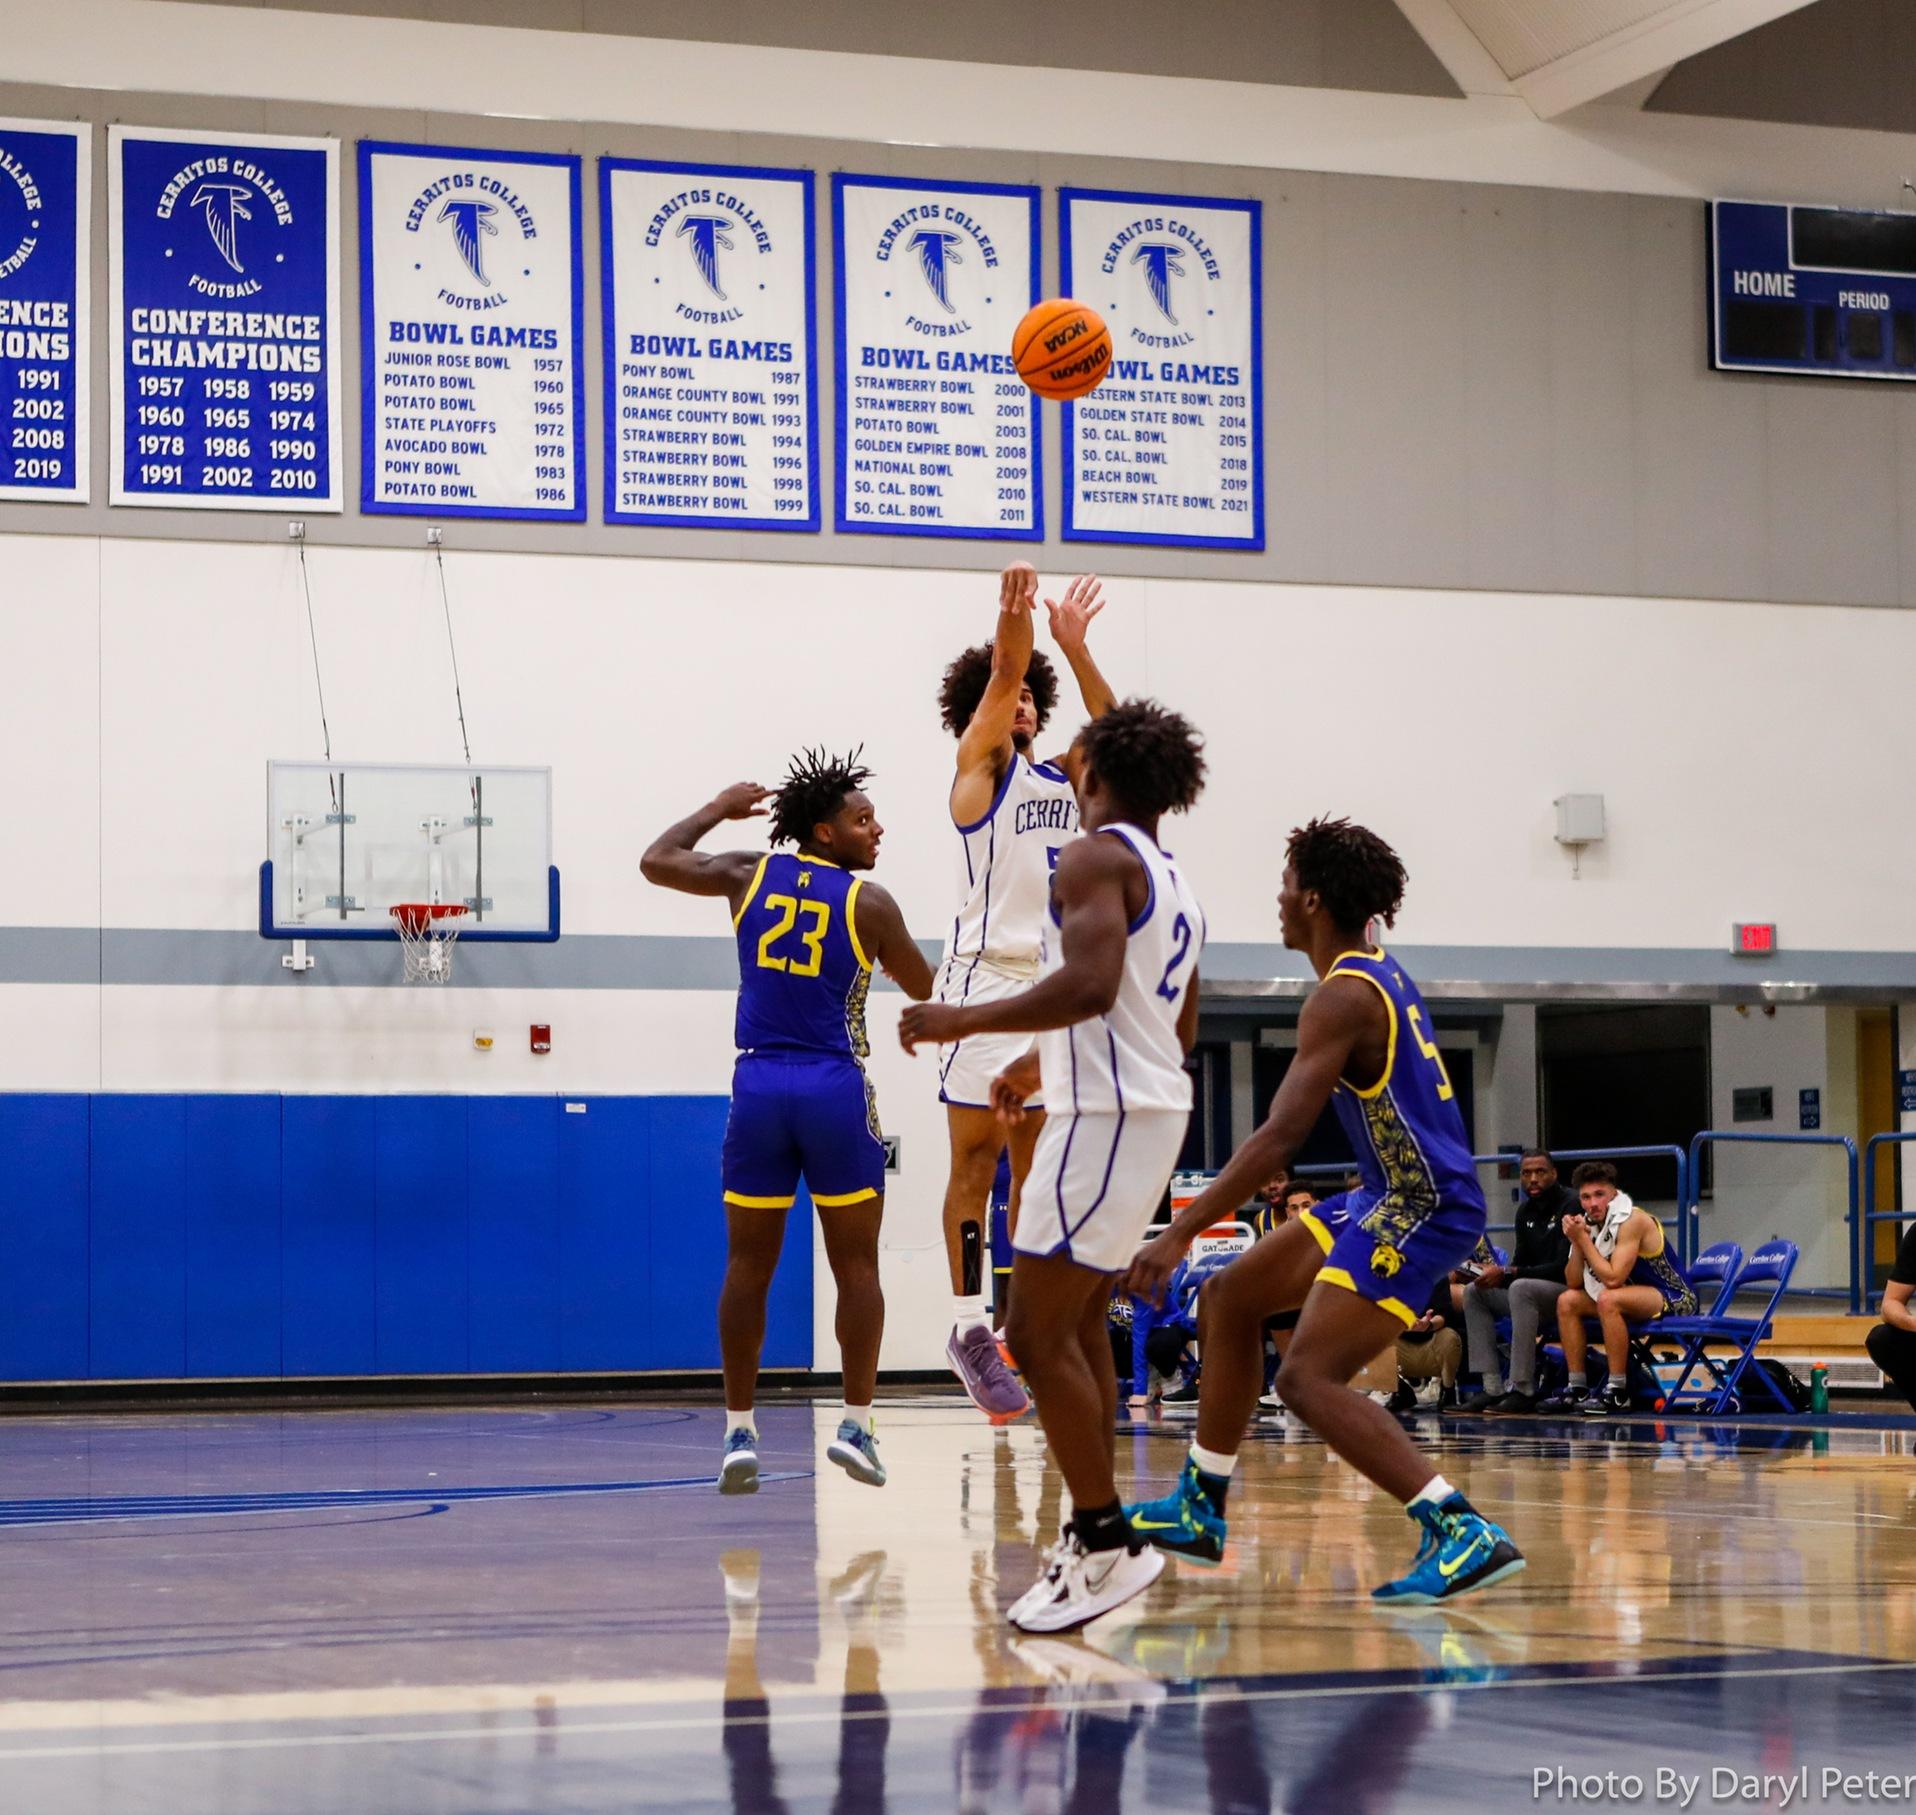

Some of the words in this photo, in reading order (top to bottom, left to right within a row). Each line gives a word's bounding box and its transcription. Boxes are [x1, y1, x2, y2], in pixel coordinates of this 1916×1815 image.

[0, 148, 42, 211] LLEGE
[157, 156, 229, 220] CERRITOS
[231, 159, 293, 226] COLLEGE
[406, 174, 474, 233] CERRITOS
[479, 176, 537, 240] COLLEGE
[645, 189, 711, 248] CERRITOS
[716, 192, 772, 254] COLLEGE
[876, 204, 940, 262] CERRITOS
[945, 208, 999, 268] COLLEGE
[1101, 218, 1164, 274] CERRITOS
[1168, 221, 1221, 280] COLLEGE
[188, 273, 262, 298] FOOTBALL
[1734, 270, 1795, 297] HOME
[437, 288, 508, 311] FOOTBALL
[1839, 291, 1890, 310] PERIOD
[675, 303, 744, 325] FOOTBALL
[132, 309, 320, 340] CONFERENCE
[905, 315, 972, 337] FOOTBALL
[390, 322, 463, 344] BOWL
[471, 326, 557, 349] GAMES
[1131, 327, 1195, 349] FOOTBALL
[132, 339, 320, 372] CHAMPIONS
[631, 335, 701, 357] BOWL
[709, 339, 792, 362] GAMES
[862, 347, 930, 369] BOWL
[385, 352, 432, 366] JUNIOR
[438, 354, 470, 368] ROSE
[475, 356, 510, 369] BOWL
[534, 359, 562, 372] 1957
[18, 370, 59, 390] 1991
[623, 364, 656, 377] PONY
[661, 367, 694, 380] BOWL
[772, 372, 800, 384] 1987
[1106, 360, 1154, 382] WL
[1161, 363, 1239, 385] GAMES
[139, 376, 184, 396] 1957
[204, 379, 250, 399] 1958
[269, 382, 314, 401] 1959
[385, 374, 435, 388] POTATO
[440, 376, 475, 389] BOWL
[534, 380, 563, 393] 1960
[855, 376, 936, 392] STRAWBERRY
[941, 381, 974, 394] BOWL
[995, 384, 1025, 396] 2000
[385, 396, 435, 409] POTATO
[440, 398, 475, 411] BOWL
[535, 402, 564, 415] 1965
[623, 386, 672, 400] ORANGE
[677, 389, 727, 402] COUNTY
[733, 392, 766, 404] BOWL
[774, 393, 798, 405] 1991
[1140, 390, 1176, 404] STATE
[1182, 393, 1213, 406] BOWL
[1219, 395, 1245, 408] 2013
[13, 399, 64, 420] 2002
[623, 407, 672, 421] ORANGE
[677, 410, 728, 423] COUNTY
[733, 413, 766, 426] BOWL
[772, 414, 800, 427] 1993
[856, 397, 936, 412] STRAWBERRY
[941, 402, 974, 415] BOWL
[997, 405, 1024, 417] 2001
[138, 406, 184, 426] 1960
[204, 408, 250, 428] 1965
[270, 411, 314, 431] 1974
[386, 417, 425, 430] STATE
[430, 419, 496, 433] PLAYOFFS
[535, 424, 564, 436] 1972
[856, 418, 902, 432] POTATO
[907, 421, 939, 434] BOWL
[996, 426, 1026, 438] 2003
[1080, 408, 1126, 421] GOLDEN
[1131, 411, 1167, 424] STATE
[1172, 413, 1204, 426] BOWL
[1219, 416, 1246, 428] 2014
[12, 428, 64, 449] 2008
[139, 435, 184, 455] 1978
[204, 438, 250, 457] 1986
[270, 440, 315, 460] 1990
[623, 428, 707, 444] STRAWBERRY
[712, 433, 746, 446] BOWL
[773, 436, 801, 448] 1994
[1082, 428, 1100, 440] SO.
[1105, 429, 1130, 441] CAL.
[1135, 430, 1166, 443] BOWL
[1220, 434, 1246, 447] 2015
[385, 439, 446, 453] AVOCADO
[452, 442, 486, 455] BOWL
[535, 445, 564, 458] 1978
[855, 439, 902, 452] GOLDEN
[907, 442, 950, 455] EMPIRE
[956, 444, 988, 458] BOWL
[996, 446, 1026, 459] 2008
[15, 459, 61, 478] 2019
[385, 460, 419, 474] PONY
[425, 463, 460, 475] BOWL
[536, 466, 565, 479] 1983
[624, 450, 708, 465] STRAWBERRY
[713, 454, 747, 467] BOWL
[774, 457, 802, 469] 1996
[855, 460, 915, 474] NATIONAL
[920, 464, 953, 476] BOWL
[996, 467, 1027, 479] 2009
[1082, 450, 1100, 461] SO.
[1105, 450, 1131, 462] CAL.
[1136, 452, 1167, 464] BOWL
[1221, 458, 1247, 470] 2018
[141, 464, 181, 484] 1991
[203, 467, 252, 486] 2002
[271, 469, 316, 489] 2010
[623, 472, 708, 486] STRAWBERRY
[713, 476, 747, 488] BOWL
[774, 478, 802, 490] 1998
[1082, 470, 1121, 482] BEACH
[1126, 472, 1157, 484] BOWL
[1221, 478, 1247, 490] 2019
[385, 482, 436, 496] POTATO
[441, 485, 476, 498] BOWL
[536, 488, 565, 500] 1986
[855, 481, 874, 493] SO.
[879, 482, 905, 495] CAL.
[910, 484, 943, 496] BOWL
[998, 488, 1026, 500] 2010
[623, 493, 708, 508] STRAWBERRY
[714, 497, 748, 510] BOWL
[775, 499, 802, 511] 1999
[854, 502, 874, 514] SO.
[878, 503, 905, 516] CAL.
[910, 505, 943, 518] BOWL
[1000, 509, 1024, 520] 2011
[1082, 491, 1137, 503] WESTERN
[1142, 493, 1178, 507] STATE
[1183, 496, 1215, 509] BOWL
[1222, 499, 1247, 511] 2021
[757, 893, 832, 977] 23
[1157, 912, 1192, 1003] 2
[1406, 1003, 1454, 1102] 5
